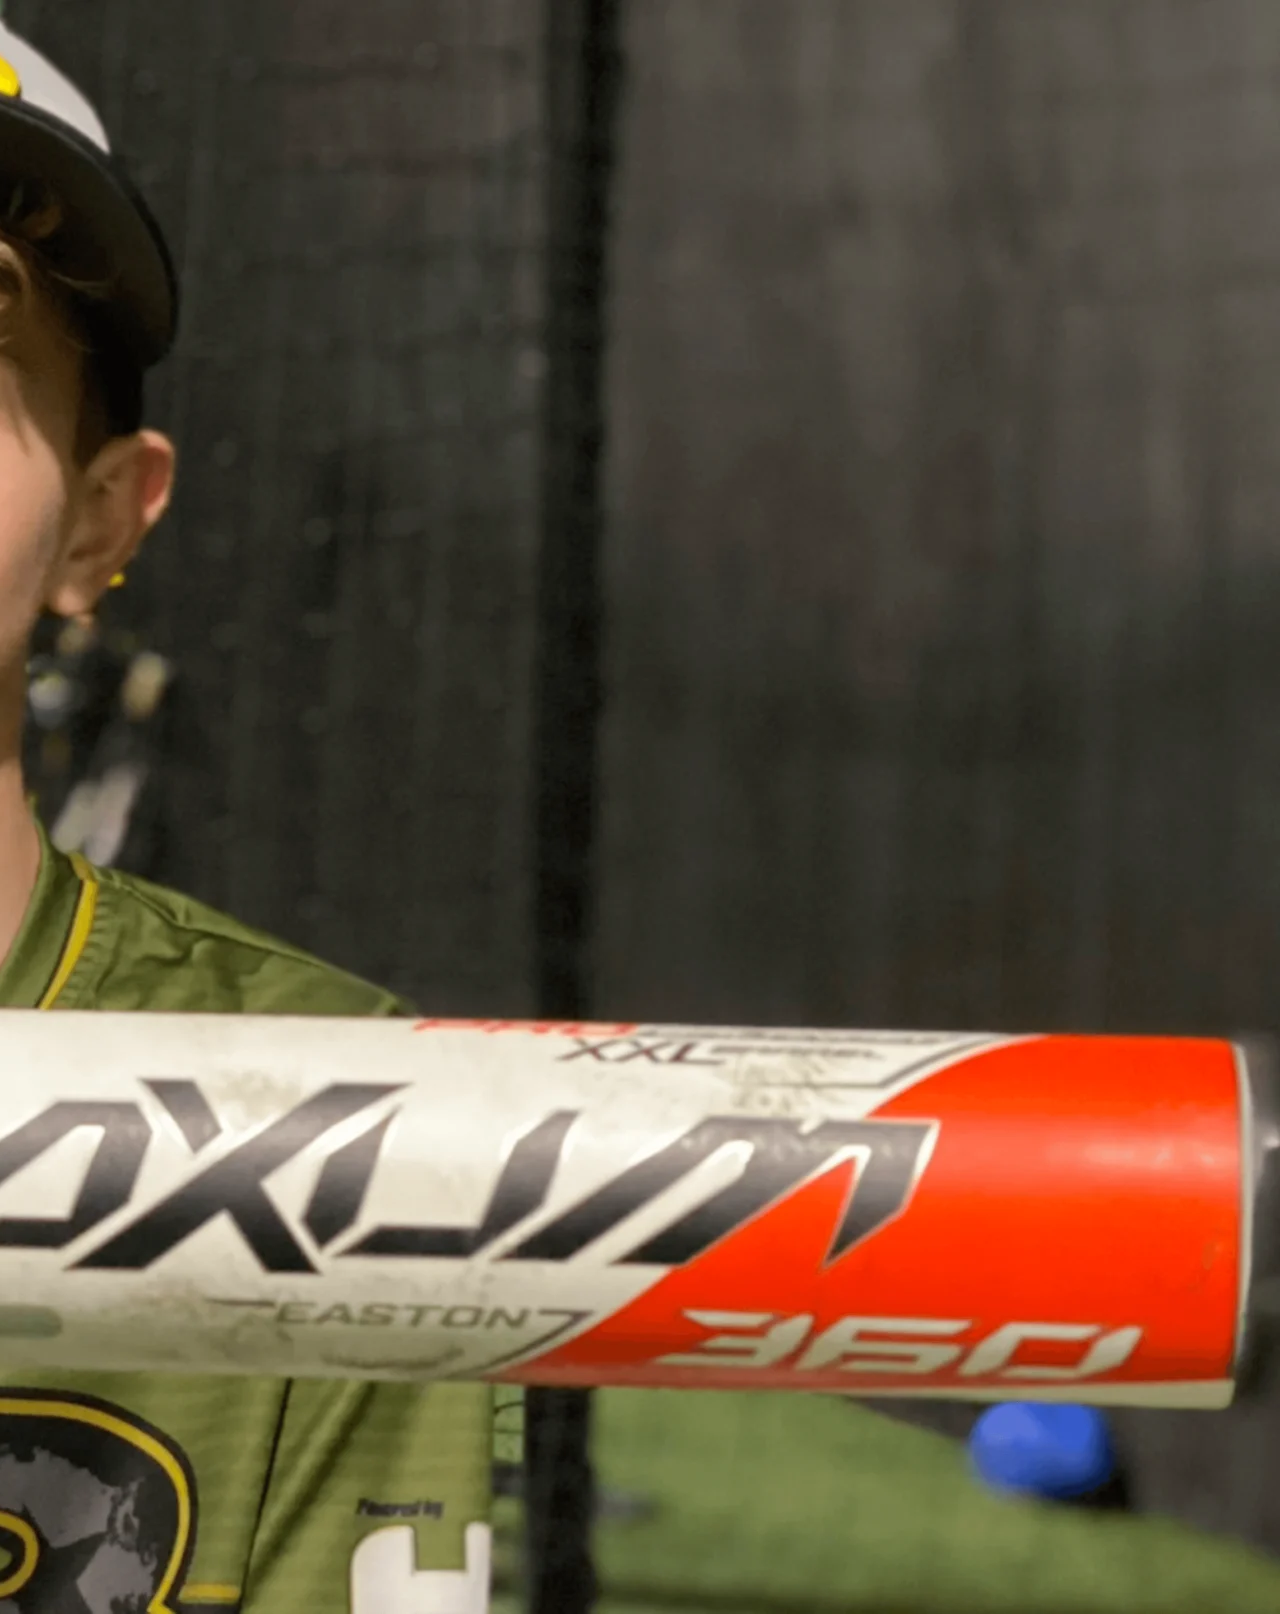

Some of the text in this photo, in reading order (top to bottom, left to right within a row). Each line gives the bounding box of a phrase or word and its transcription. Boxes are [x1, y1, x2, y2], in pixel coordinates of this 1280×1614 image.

[556, 1036, 724, 1066] XXL
[275, 1302, 531, 1329] EASTON
[655, 1308, 1142, 1379] 360
